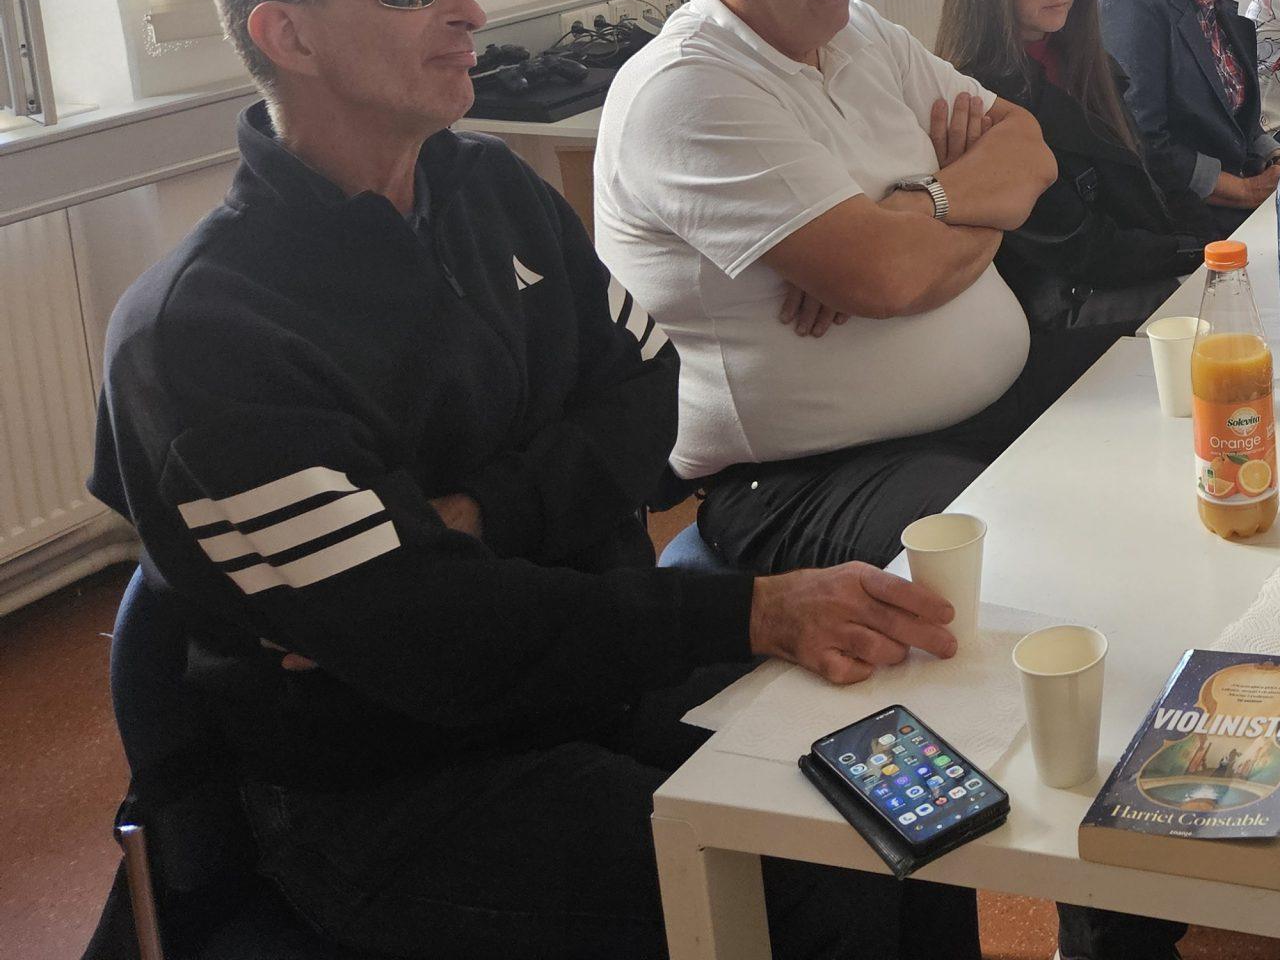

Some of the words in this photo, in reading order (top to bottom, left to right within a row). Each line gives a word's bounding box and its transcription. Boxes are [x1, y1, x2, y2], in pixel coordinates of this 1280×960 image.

[1227, 415, 1260, 427] Solevita
[1209, 435, 1262, 451] Orange
[1110, 803, 1174, 824] Harriet
[1178, 811, 1271, 827] Constable
